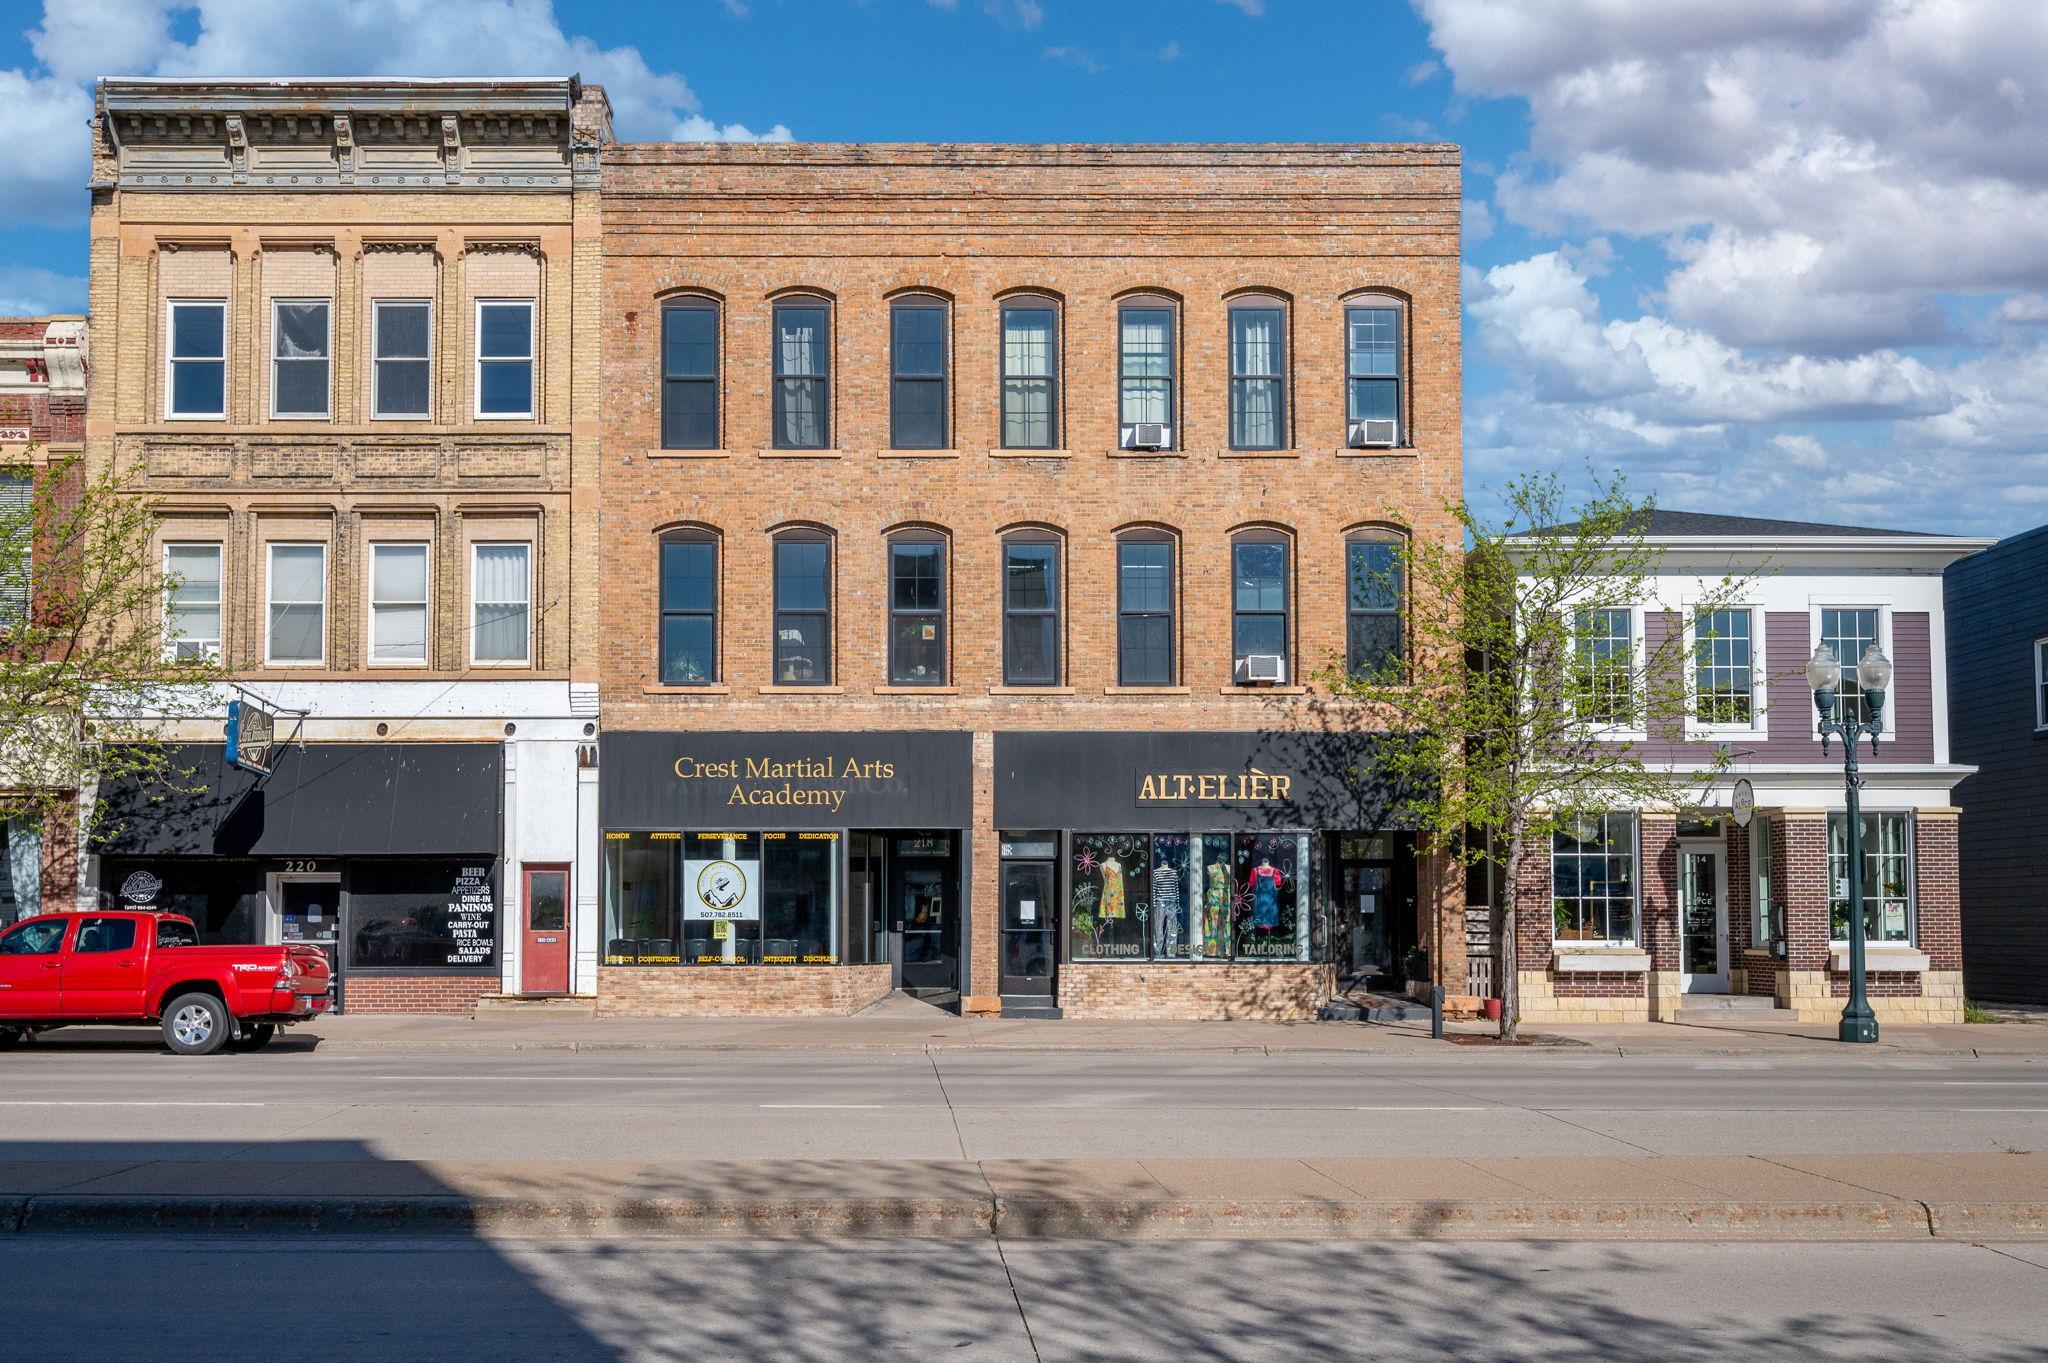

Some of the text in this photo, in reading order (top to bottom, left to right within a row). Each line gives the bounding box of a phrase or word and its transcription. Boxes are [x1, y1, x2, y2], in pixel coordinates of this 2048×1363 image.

[674, 756, 895, 779] Crest Martial Arts
[726, 783, 847, 813] Academy
[606, 832, 682, 840] HONOR ATTITUDE
[913, 839, 934, 848] 218
[285, 861, 317, 872] 220
[461, 867, 486, 877] BEER
[455, 877, 481, 886] PIZZA
[451, 886, 490, 895] APPETIZERS
[461, 895, 491, 903] DINE-IN
[448, 903, 494, 912] PANINOS
[460, 913, 482, 921] WINE
[447, 921, 490, 929] CARRY-OUT
[452, 929, 477, 938] PASTA
[456, 939, 493, 947] RICE BOWLS
[458, 946, 491, 955] SALADS
[1081, 943, 1304, 955] CLOTHING DESIG TAILORING
[447, 955, 483, 963] DELIVERY
[638, 955, 680, 963] CONFIDENCE
[763, 955, 798, 963] INTEGRITY
[232, 963, 257, 972] TRD
